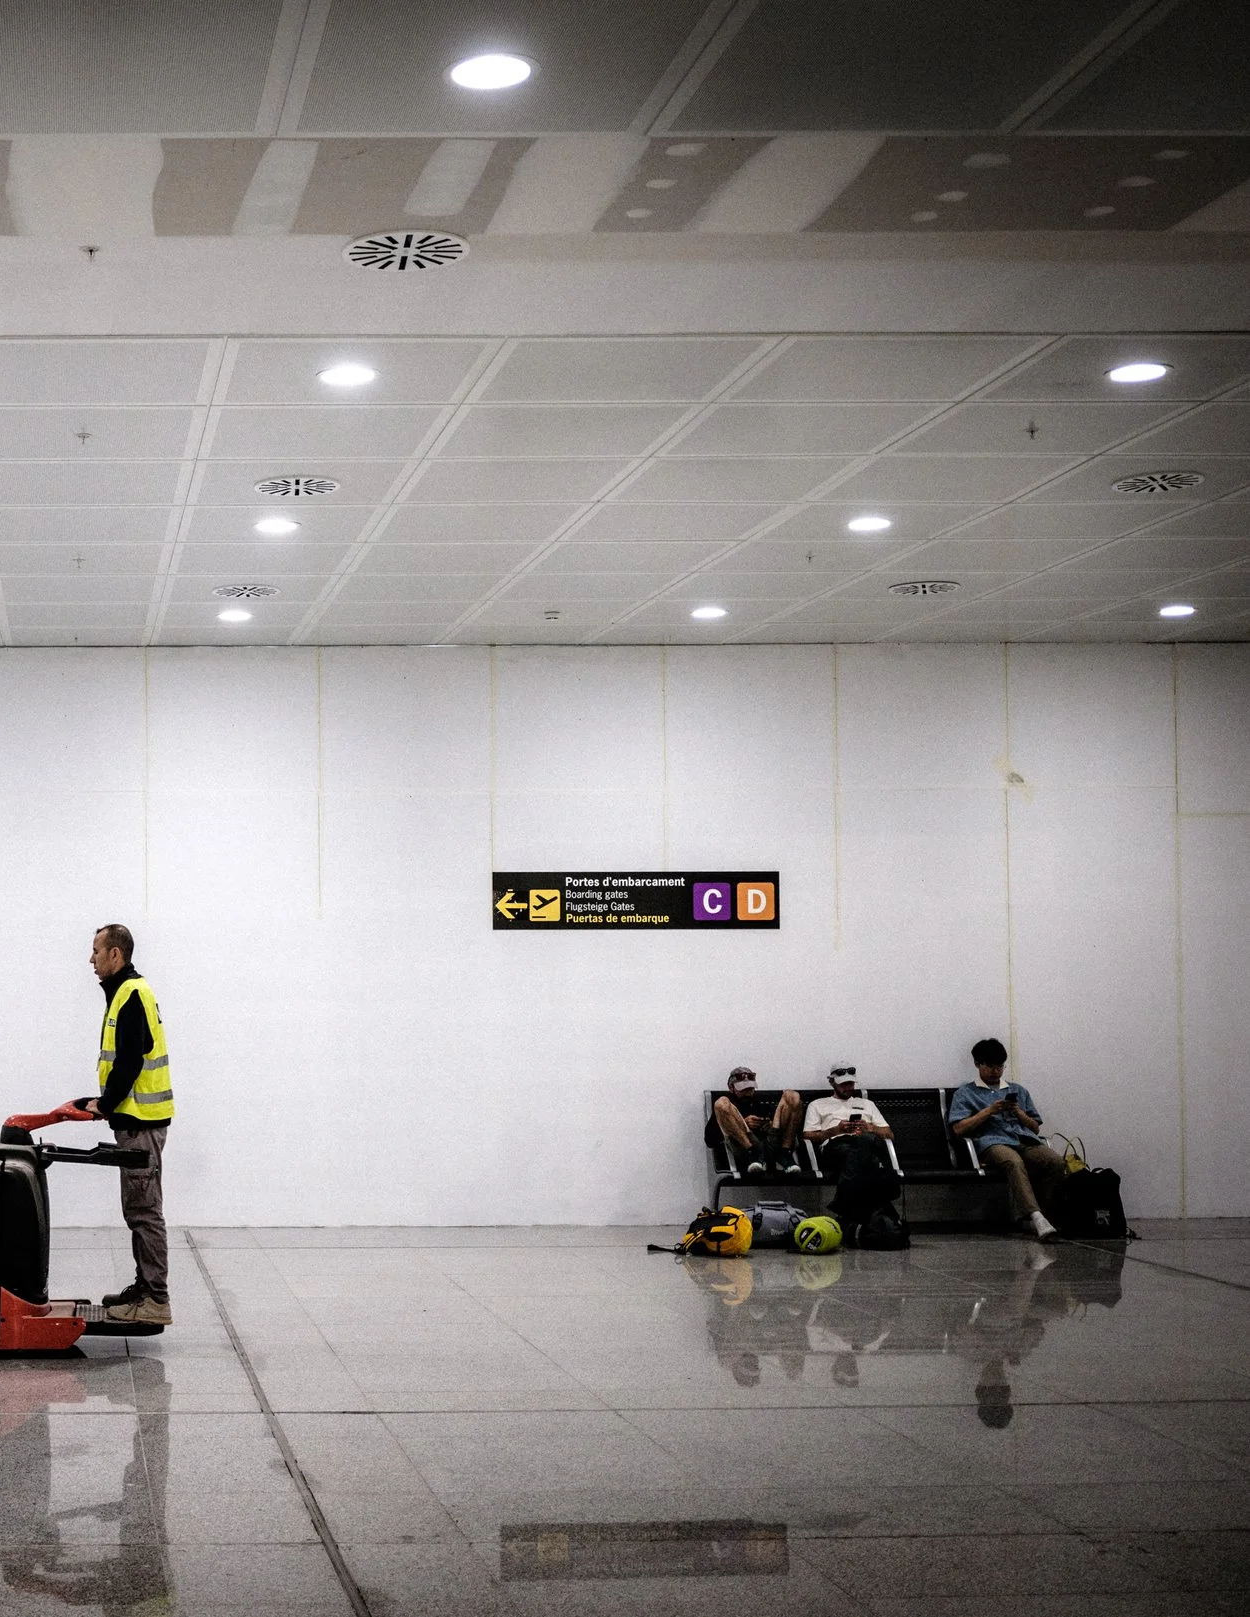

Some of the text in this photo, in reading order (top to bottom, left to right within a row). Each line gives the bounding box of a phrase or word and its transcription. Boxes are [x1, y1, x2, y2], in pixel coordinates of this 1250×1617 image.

[565, 877, 686, 887] Portes d'embarcament
[565, 889, 629, 900] Boarding gates
[565, 901, 635, 912] Flugsteige Gates
[703, 889, 767, 914] C D
[565, 913, 670, 924] Puertas de embarque
